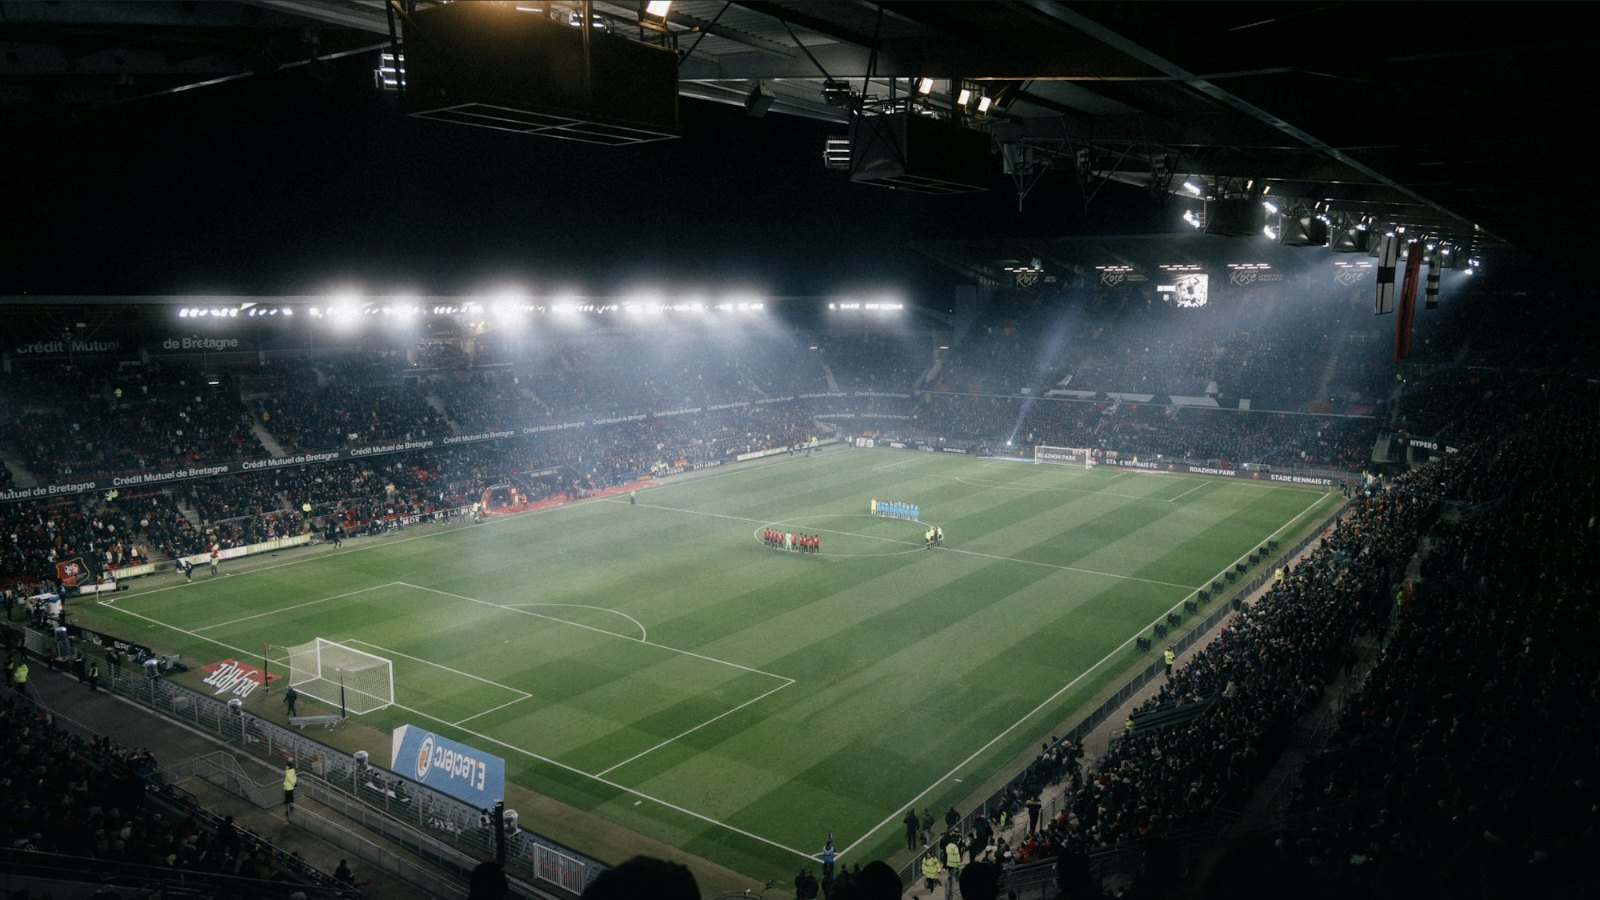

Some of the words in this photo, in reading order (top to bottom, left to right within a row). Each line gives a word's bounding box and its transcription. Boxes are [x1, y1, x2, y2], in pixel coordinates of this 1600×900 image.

[163, 338, 180, 349] de
[183, 337, 238, 350] Bretagne
[490, 430, 514, 438] Bretagne
[351, 447, 372, 456] Crédit
[373, 444, 395, 453] Mutuel
[405, 441, 433, 449] Bretagne
[1410, 440, 1432, 449] HYPER
[242, 460, 267, 470] Crédit
[268, 456, 294, 466] Mutuel
[295, 455, 305, 463] de
[305, 452, 339, 461] Bretagne
[1106, 458, 1123, 466] STAE
[113, 475, 142, 486] Crédit
[143, 471, 175, 482] Mutuel
[176, 469, 188, 479] de
[189, 466, 228, 476] Bretagne
[1189, 466, 1218, 474] ROAZHON
[1218, 468, 1236, 476] PARK
[1270, 474, 1291, 482] STADE
[1293, 476, 1322, 485] RENNAIS
[33, 487, 46, 496] de
[48, 482, 96, 493] Bretagne
